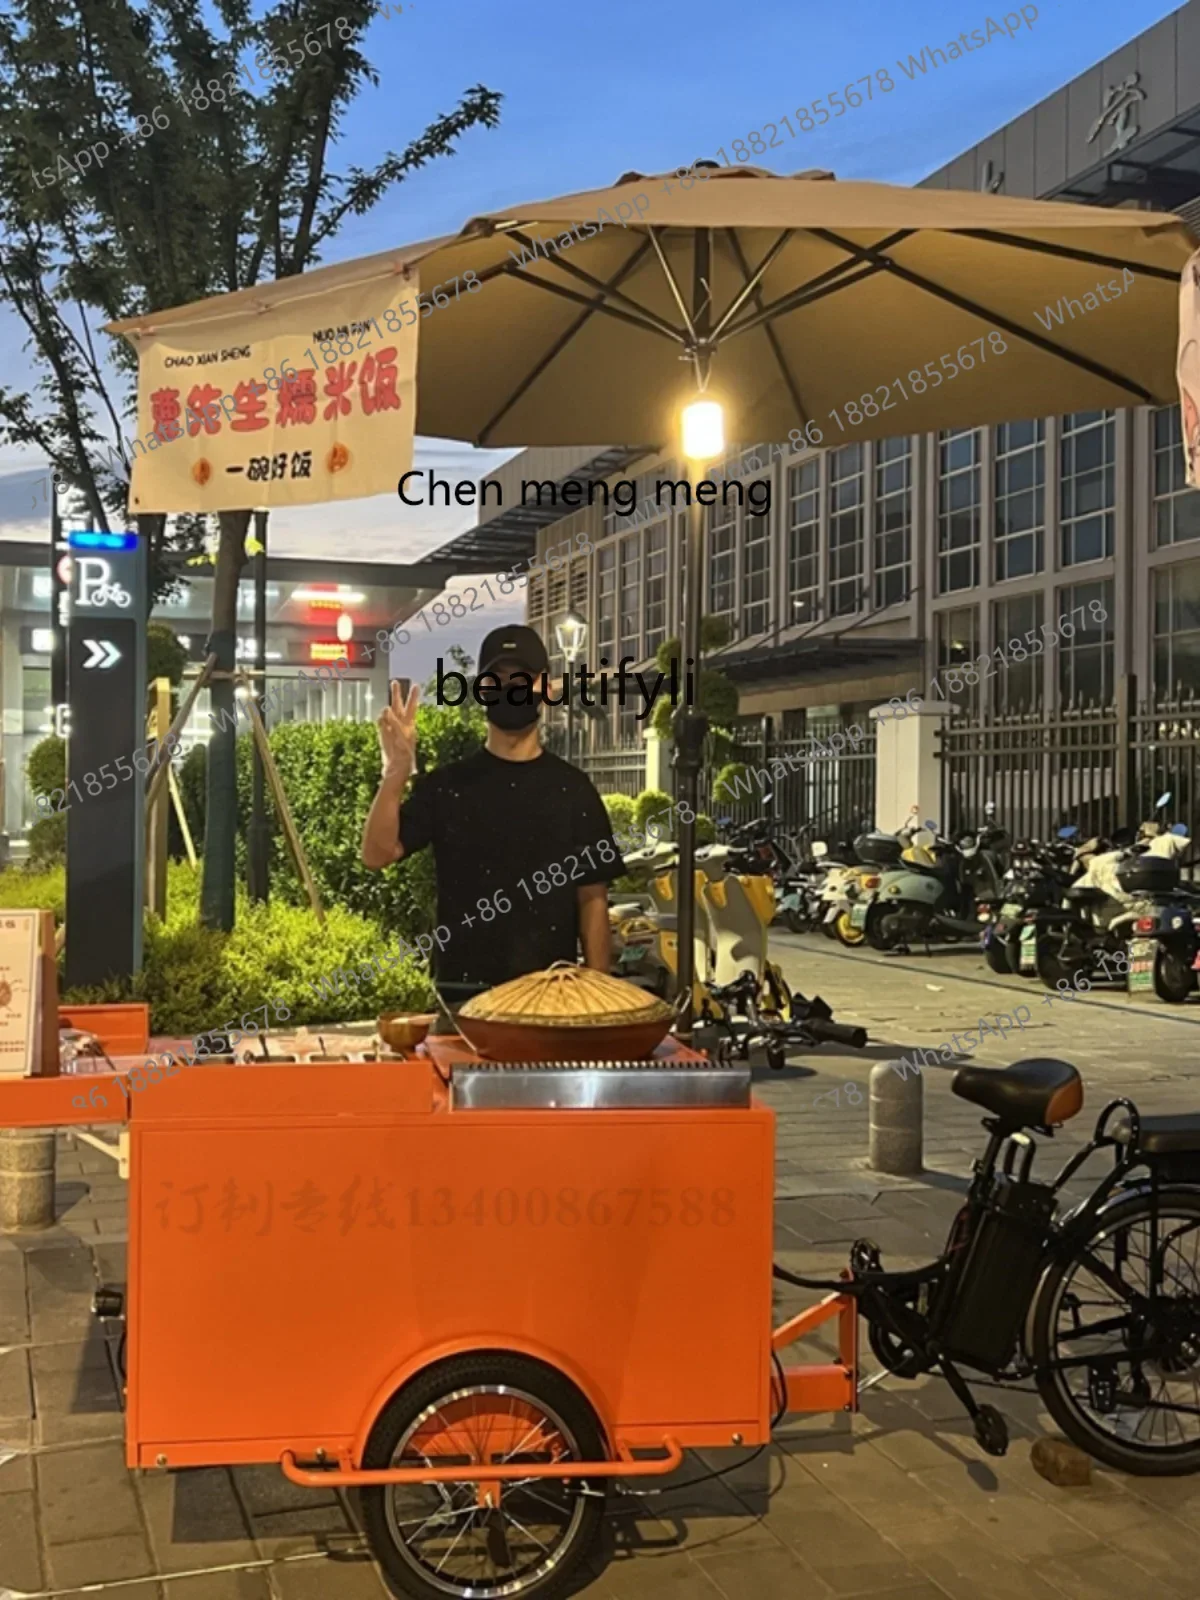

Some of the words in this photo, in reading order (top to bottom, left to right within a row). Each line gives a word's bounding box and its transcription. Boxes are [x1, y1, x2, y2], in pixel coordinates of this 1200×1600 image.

[164, 355, 194, 368] CHAO
[220, 345, 251, 362] SHENG
[150, 346, 401, 443] 曹先生糯米饭
[225, 450, 313, 482] 一碗好饭
[74, 556, 112, 606] P
